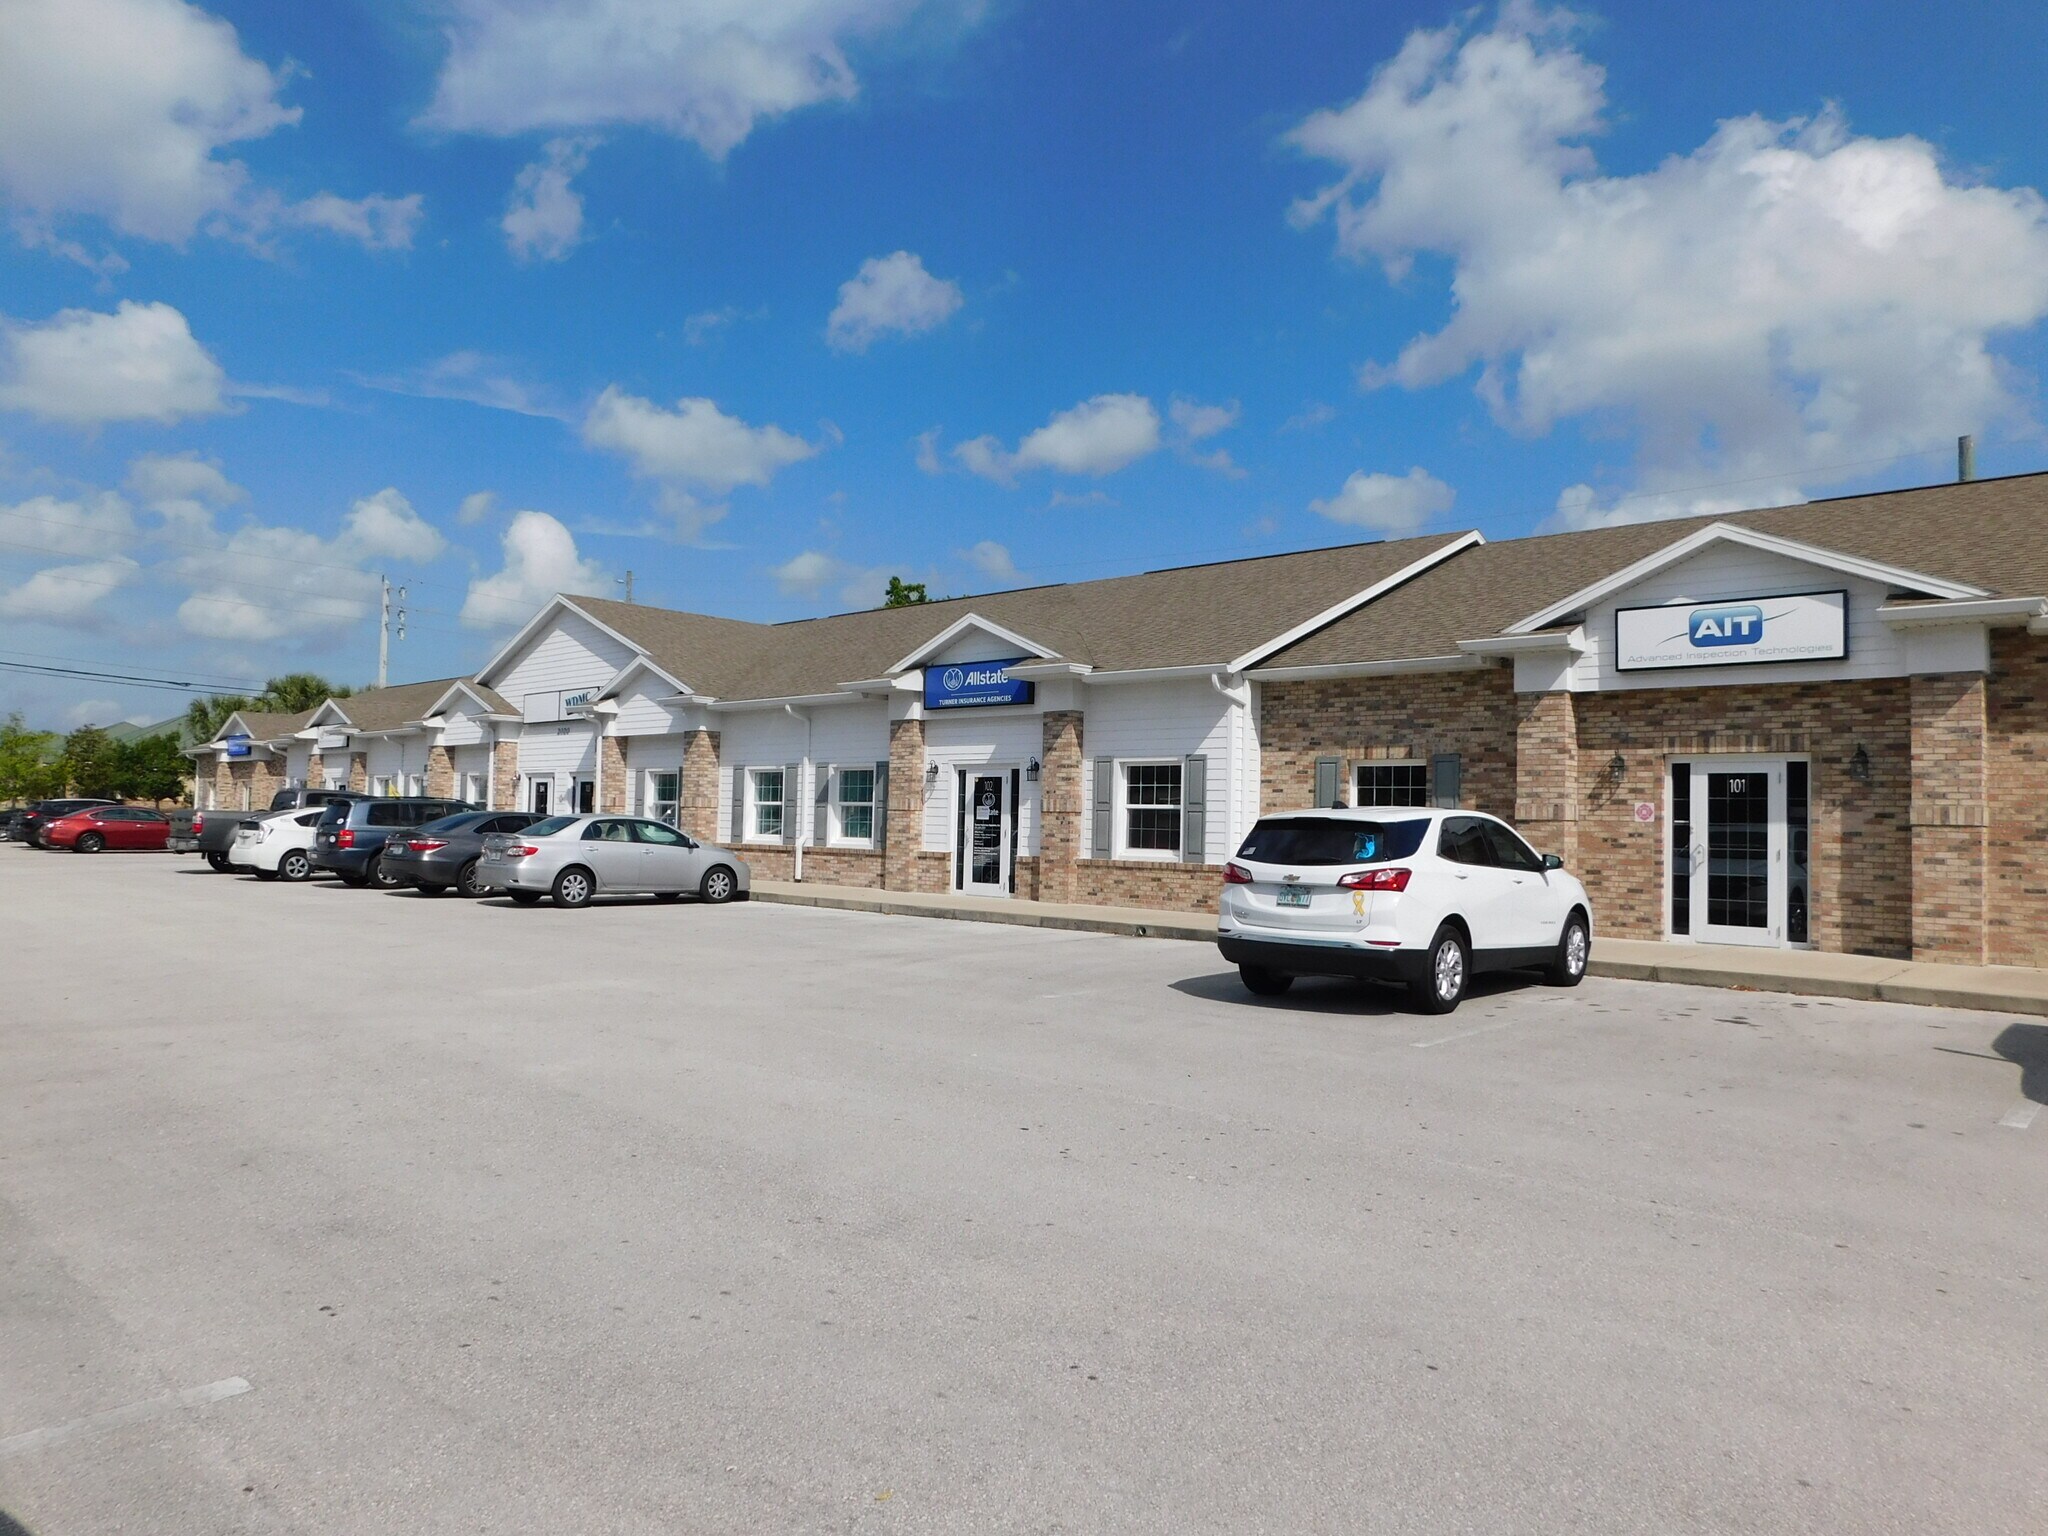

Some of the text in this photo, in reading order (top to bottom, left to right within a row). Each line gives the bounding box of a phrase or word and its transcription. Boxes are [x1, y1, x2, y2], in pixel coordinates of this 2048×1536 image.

[1694, 615, 1757, 639] AIT
[1627, 644, 1833, 663] Advanced Inspection Technologies
[964, 669, 1009, 686] Allstate
[939, 694, 1012, 706] TURNER INSURANCE AGENCIES
[1729, 778, 1746, 793] 101
